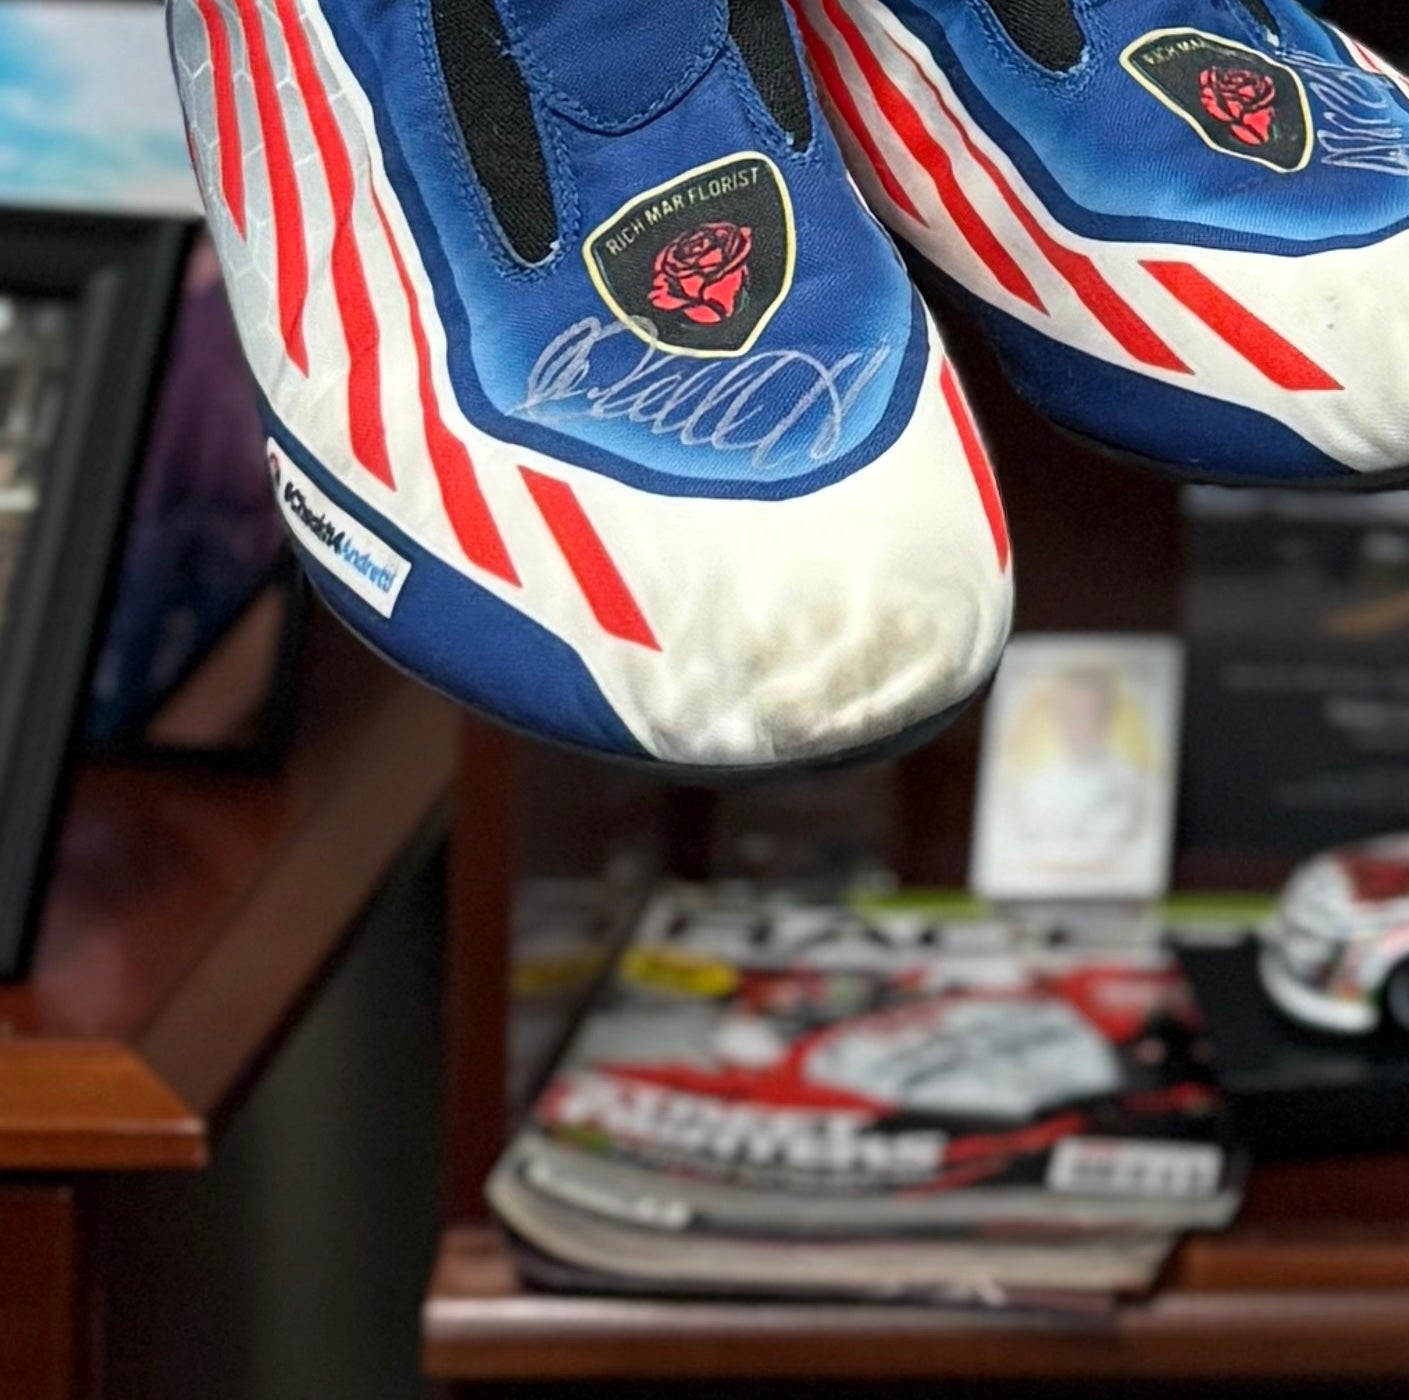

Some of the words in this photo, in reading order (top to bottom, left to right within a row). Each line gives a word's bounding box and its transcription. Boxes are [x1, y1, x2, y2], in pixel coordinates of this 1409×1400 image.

[605, 218, 645, 256] RICH
[644, 194, 684, 226] MAR
[688, 167, 759, 205] FLORIST
